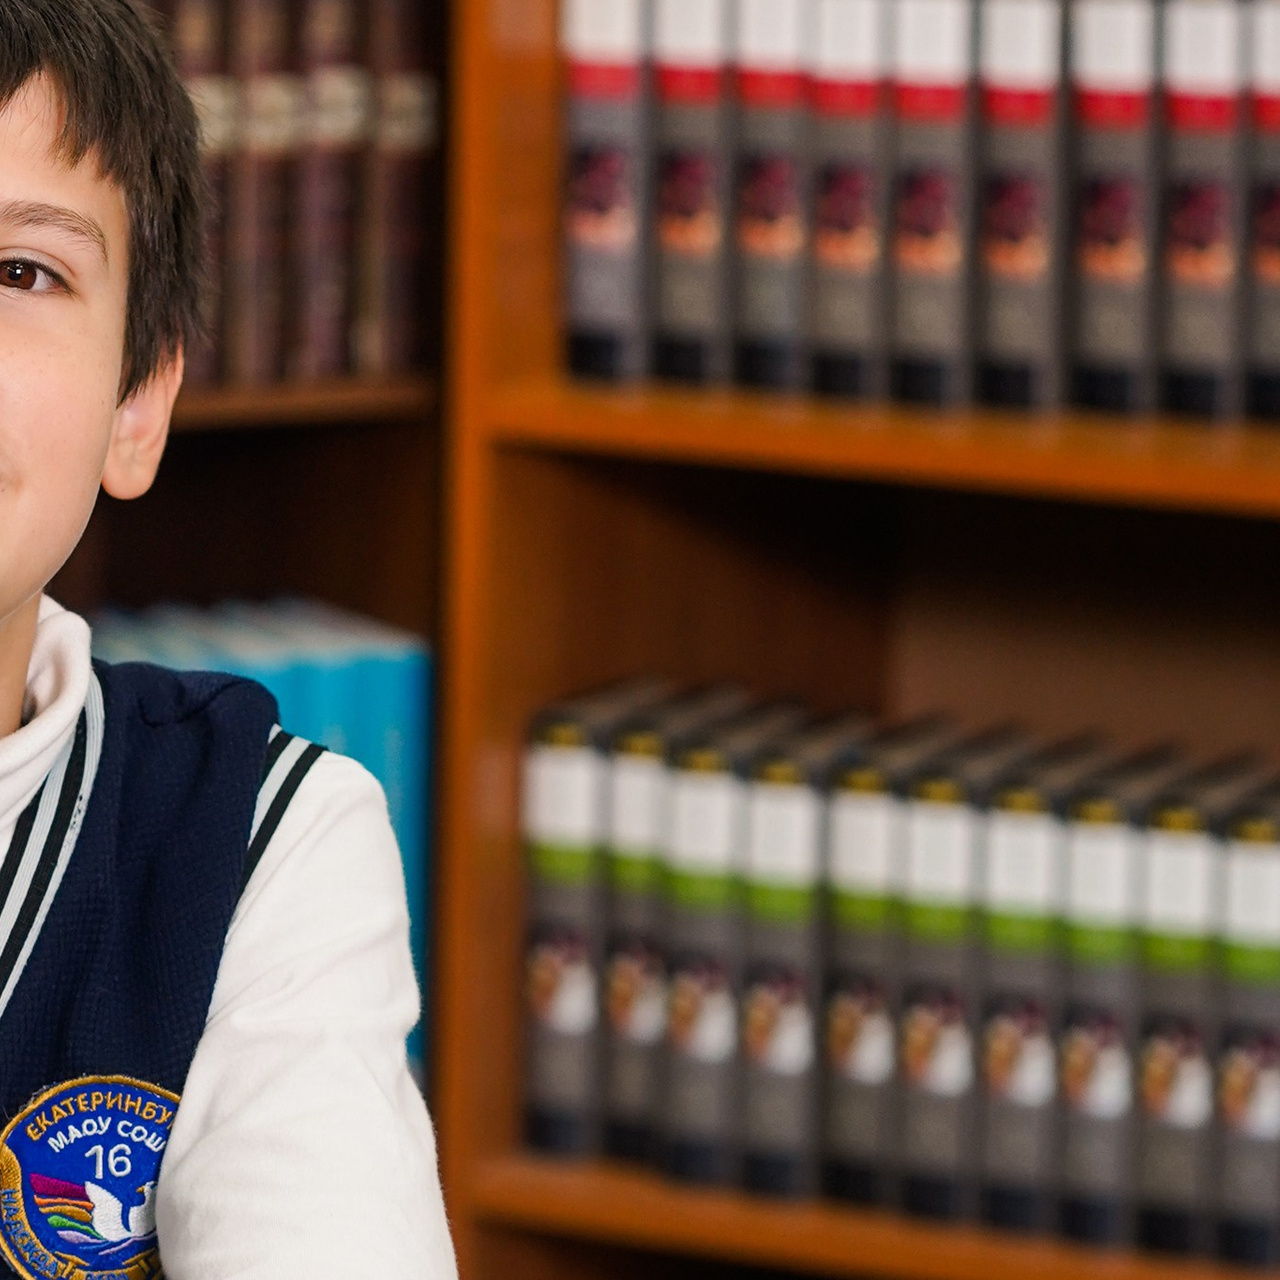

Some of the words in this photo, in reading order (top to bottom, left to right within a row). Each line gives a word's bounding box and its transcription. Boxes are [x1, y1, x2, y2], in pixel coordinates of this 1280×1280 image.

[26, 1091, 176, 1141] ЕКАТЕРИНБУ
[47, 1116, 111, 1153] МАОУ
[117, 1120, 167, 1153] СОШ
[85, 1143, 132, 1180] 16
[0, 1188, 59, 1277] НАДЕЖДА
